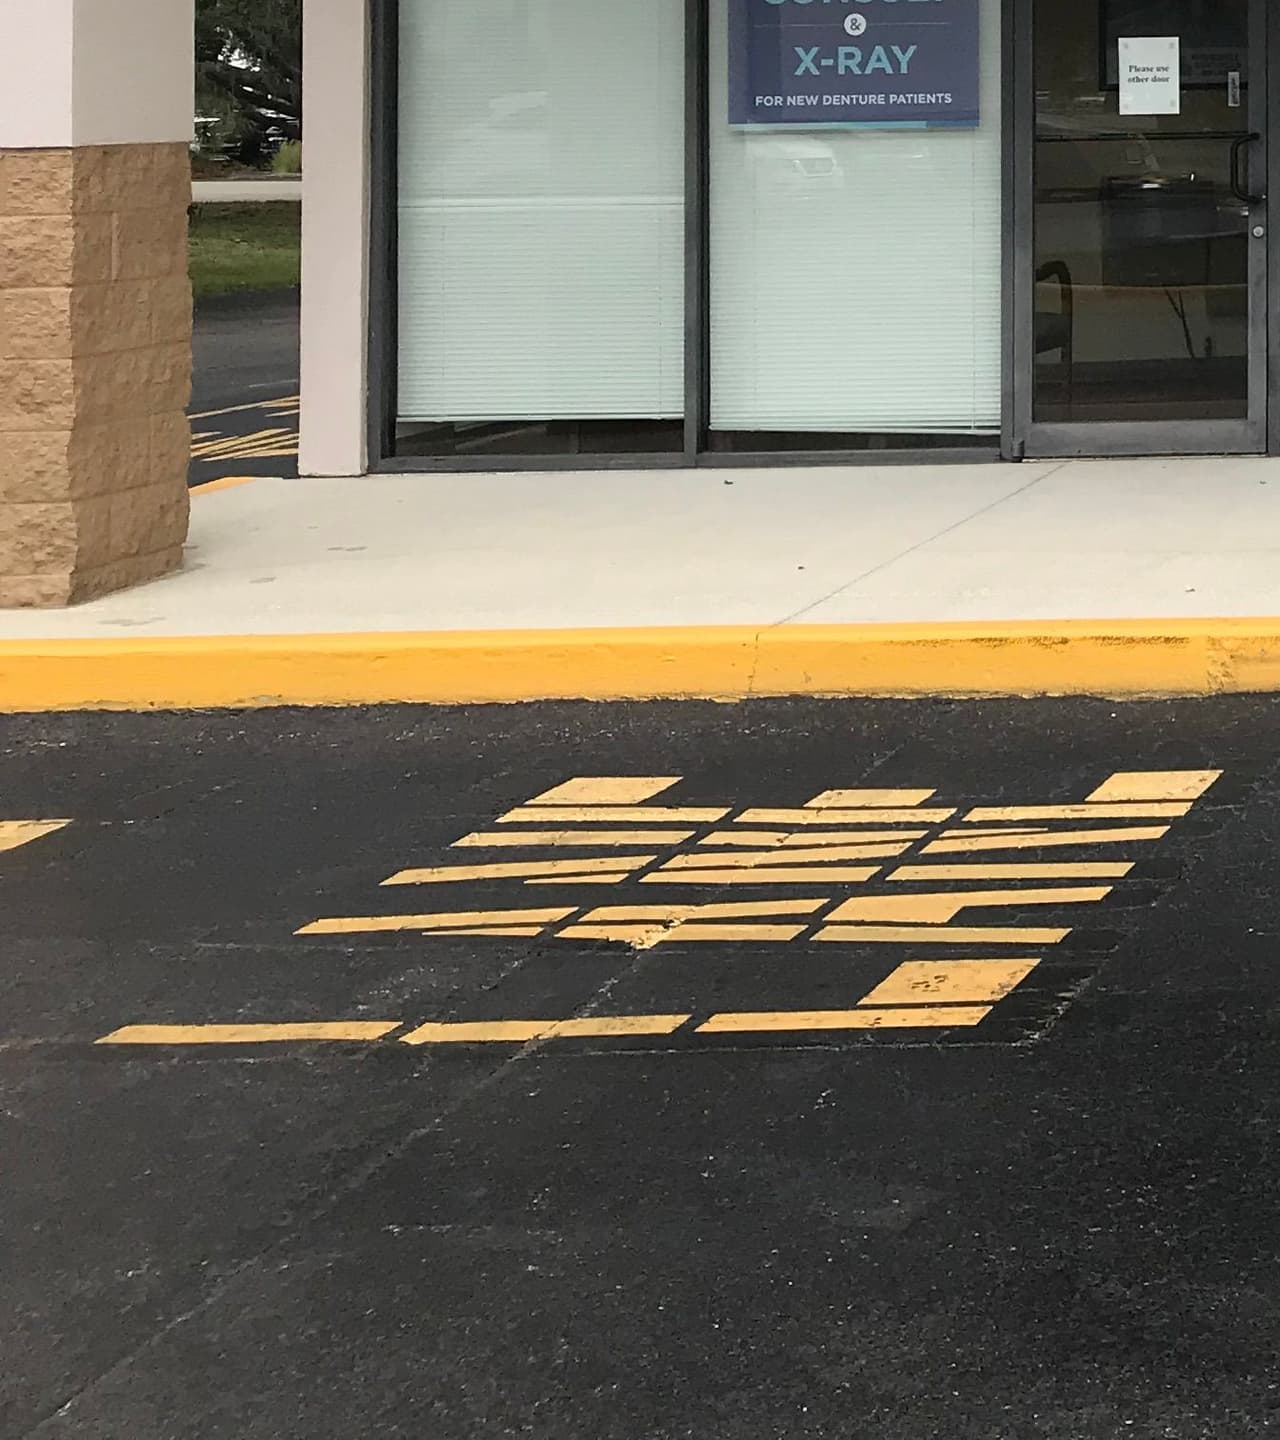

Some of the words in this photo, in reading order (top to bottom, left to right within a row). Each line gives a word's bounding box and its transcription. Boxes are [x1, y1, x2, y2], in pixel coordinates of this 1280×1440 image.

[794, 45, 917, 75] X-RAY
[1129, 65, 1153, 73] Please
[1156, 65, 1169, 73] use
[1128, 75, 1149, 83] other
[1151, 75, 1170, 83] door
[755, 96, 783, 107] FOR
[787, 95, 819, 107] NEW
[823, 94, 885, 106] DENTURE
[889, 92, 952, 105] PATIENTS
